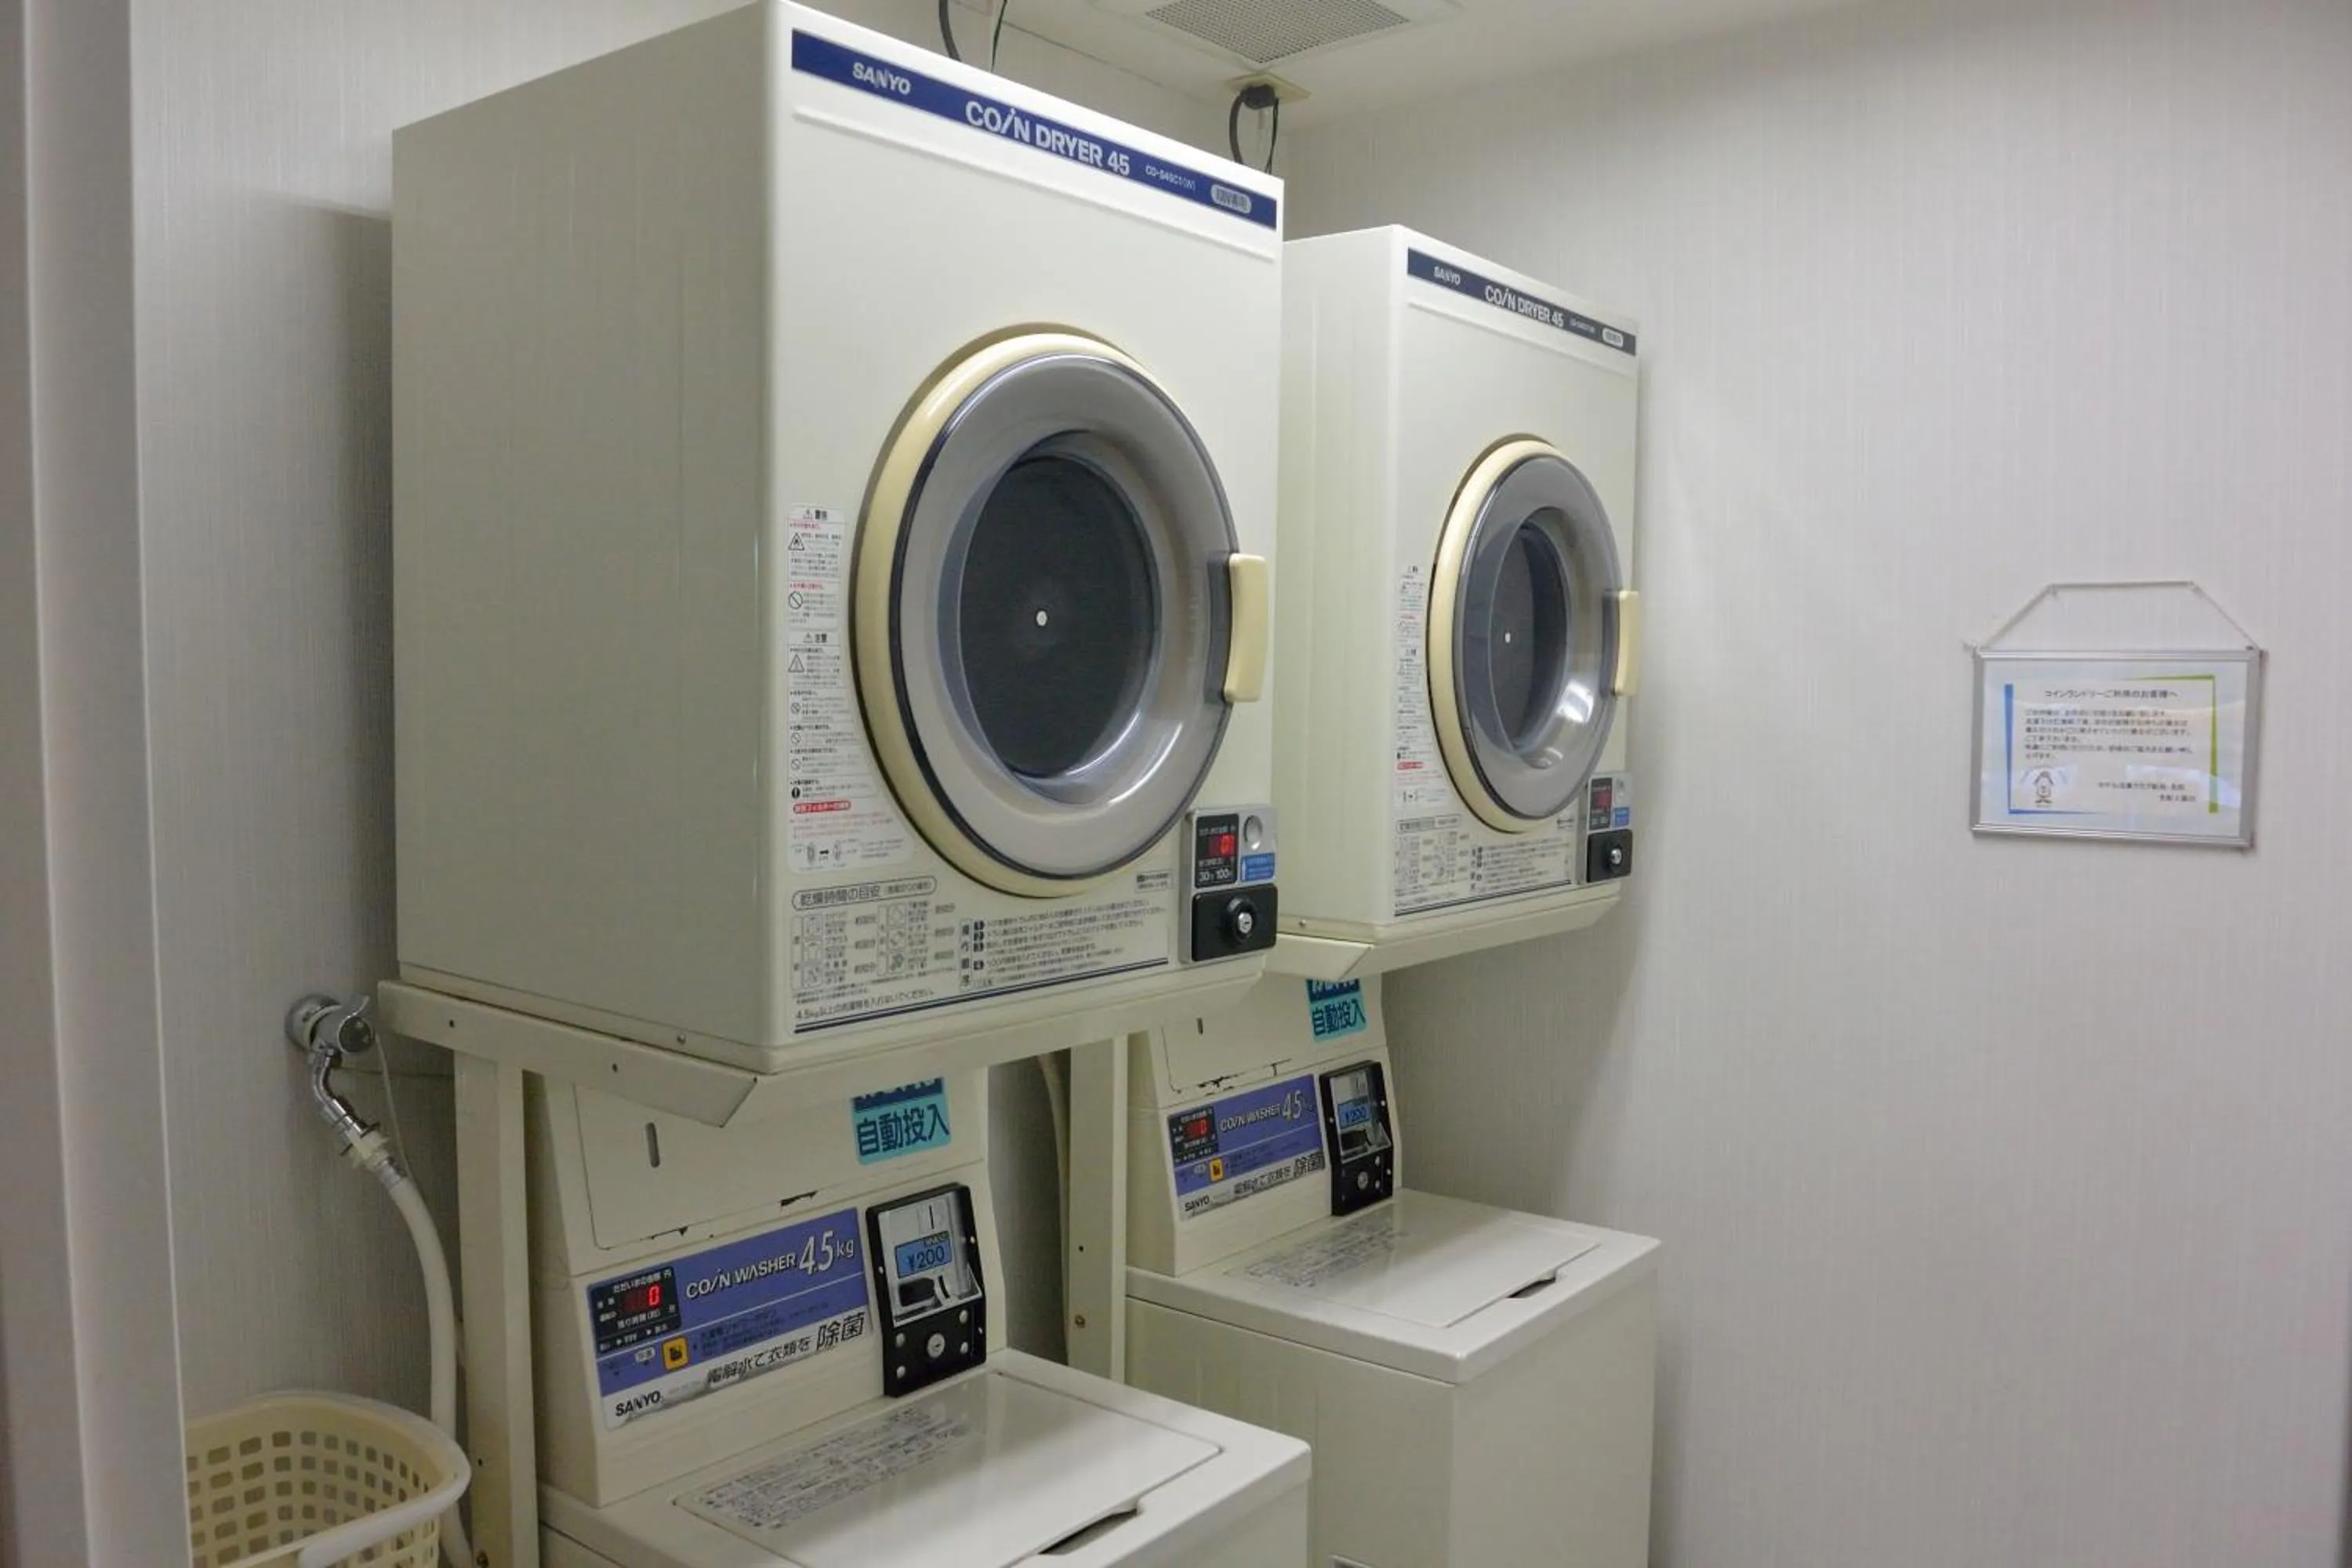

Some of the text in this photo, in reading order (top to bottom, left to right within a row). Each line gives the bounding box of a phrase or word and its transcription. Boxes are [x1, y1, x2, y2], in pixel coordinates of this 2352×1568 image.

[853, 62, 910, 96] SANYO
[1035, 123, 1102, 168] DRYER
[1107, 152, 1131, 176] 45
[1434, 266, 1461, 286] SANYO
[1517, 296, 1550, 325] DRYER
[1552, 311, 1564, 328] 45
[1312, 998, 1366, 1036] 自動投入
[856, 1103, 950, 1156] 自動投入
[1185, 1196, 1210, 1211] SANYO
[733, 1254, 796, 1284] WASHER
[907, 1244, 946, 1272] ¥200
[648, 1284, 661, 1306] 0
[816, 1311, 866, 1351] 除菌
[615, 1389, 662, 1417] SANYO
